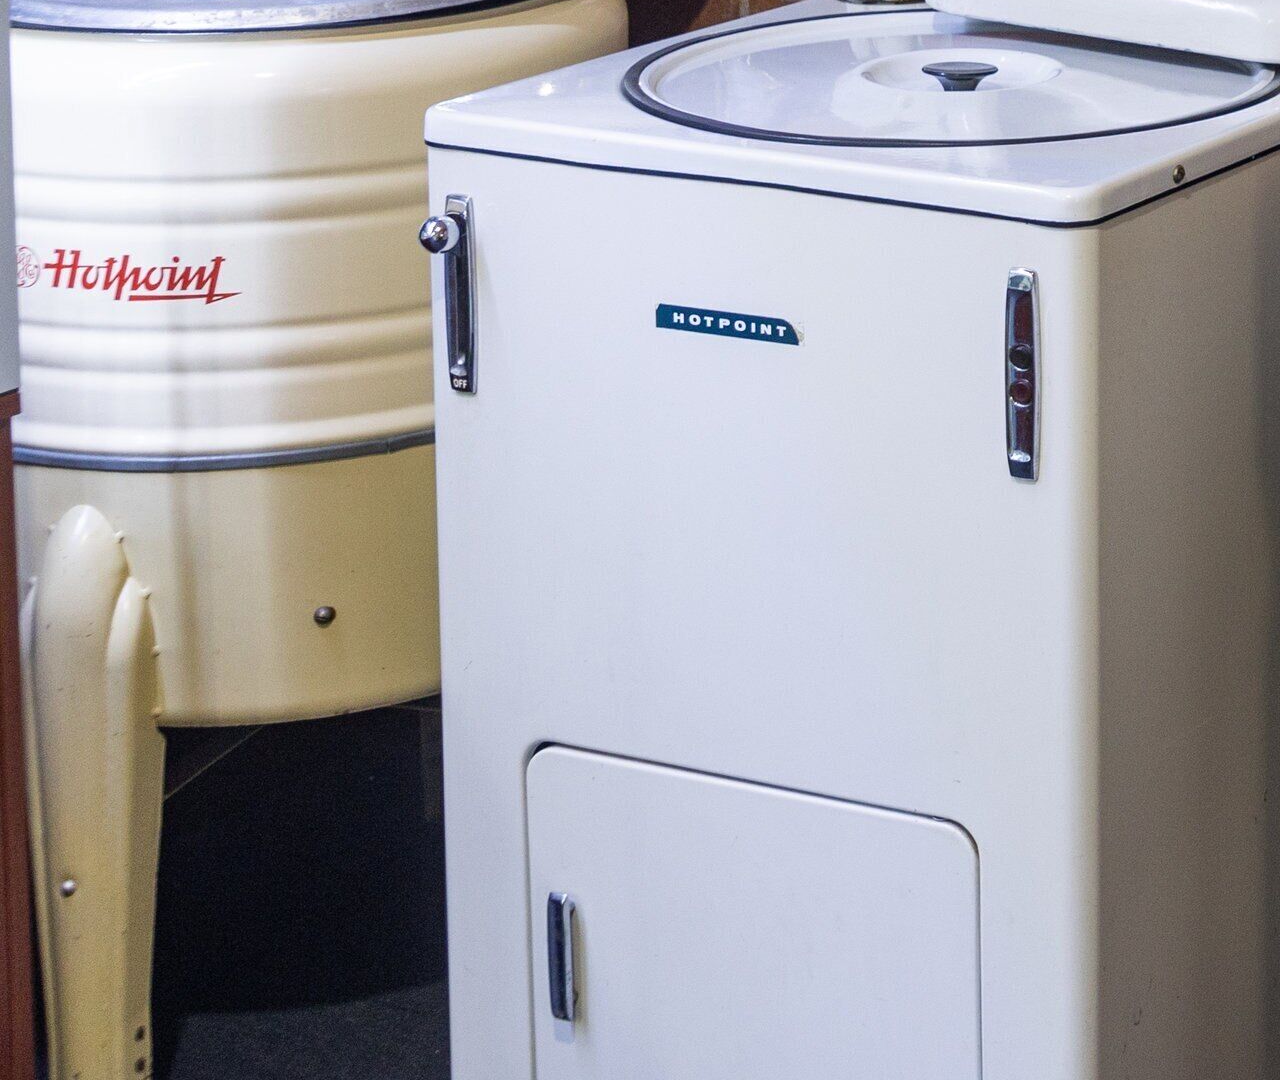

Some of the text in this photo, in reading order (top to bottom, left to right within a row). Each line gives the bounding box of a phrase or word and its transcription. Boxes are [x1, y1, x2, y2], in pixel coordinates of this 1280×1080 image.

[43, 249, 242, 304] Hotpoint
[673, 312, 787, 336] HOTPOINT
[453, 378, 468, 389] OFF
